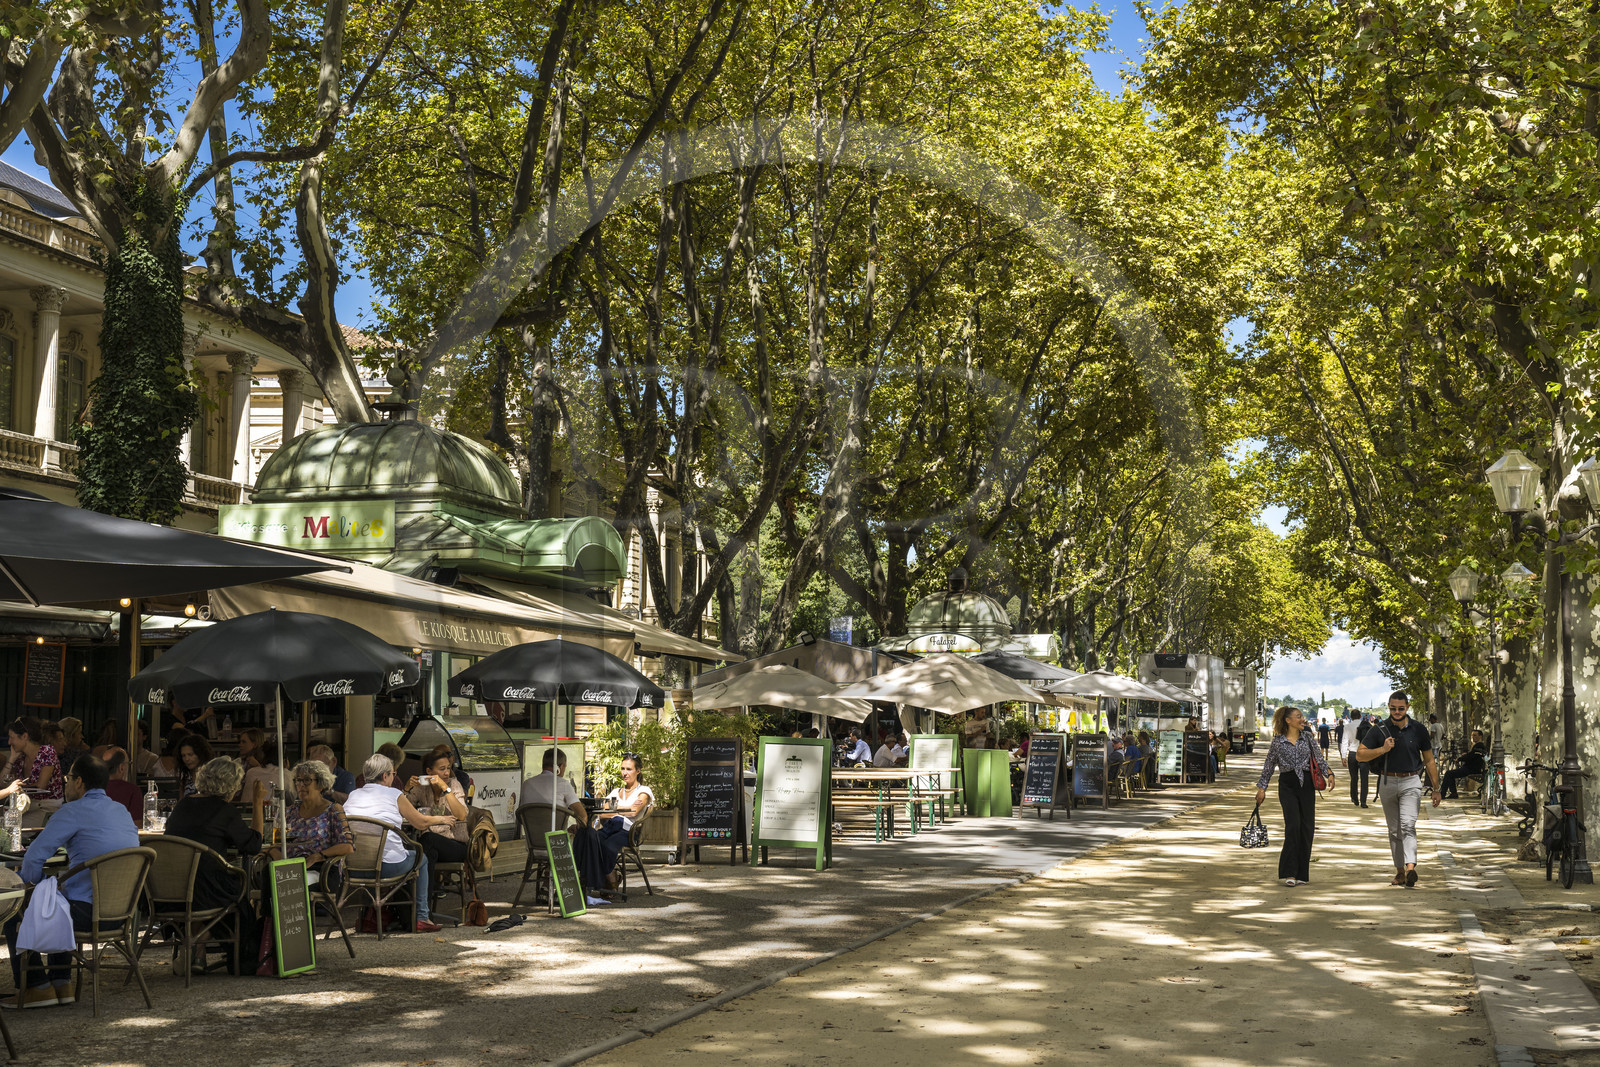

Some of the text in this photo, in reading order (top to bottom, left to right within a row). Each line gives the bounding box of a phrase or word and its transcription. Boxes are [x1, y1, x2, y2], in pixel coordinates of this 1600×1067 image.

[301, 515, 384, 538] Malices
[417, 620, 513, 647] LE KIOSQUE A MALICES
[930, 636, 957, 649] Falafel
[208, 686, 251, 704] Coca-Cola
[313, 678, 354, 698] Coca-Cola
[503, 686, 536, 700] Coca-Cola
[582, 688, 612, 703] Coca-Cola
